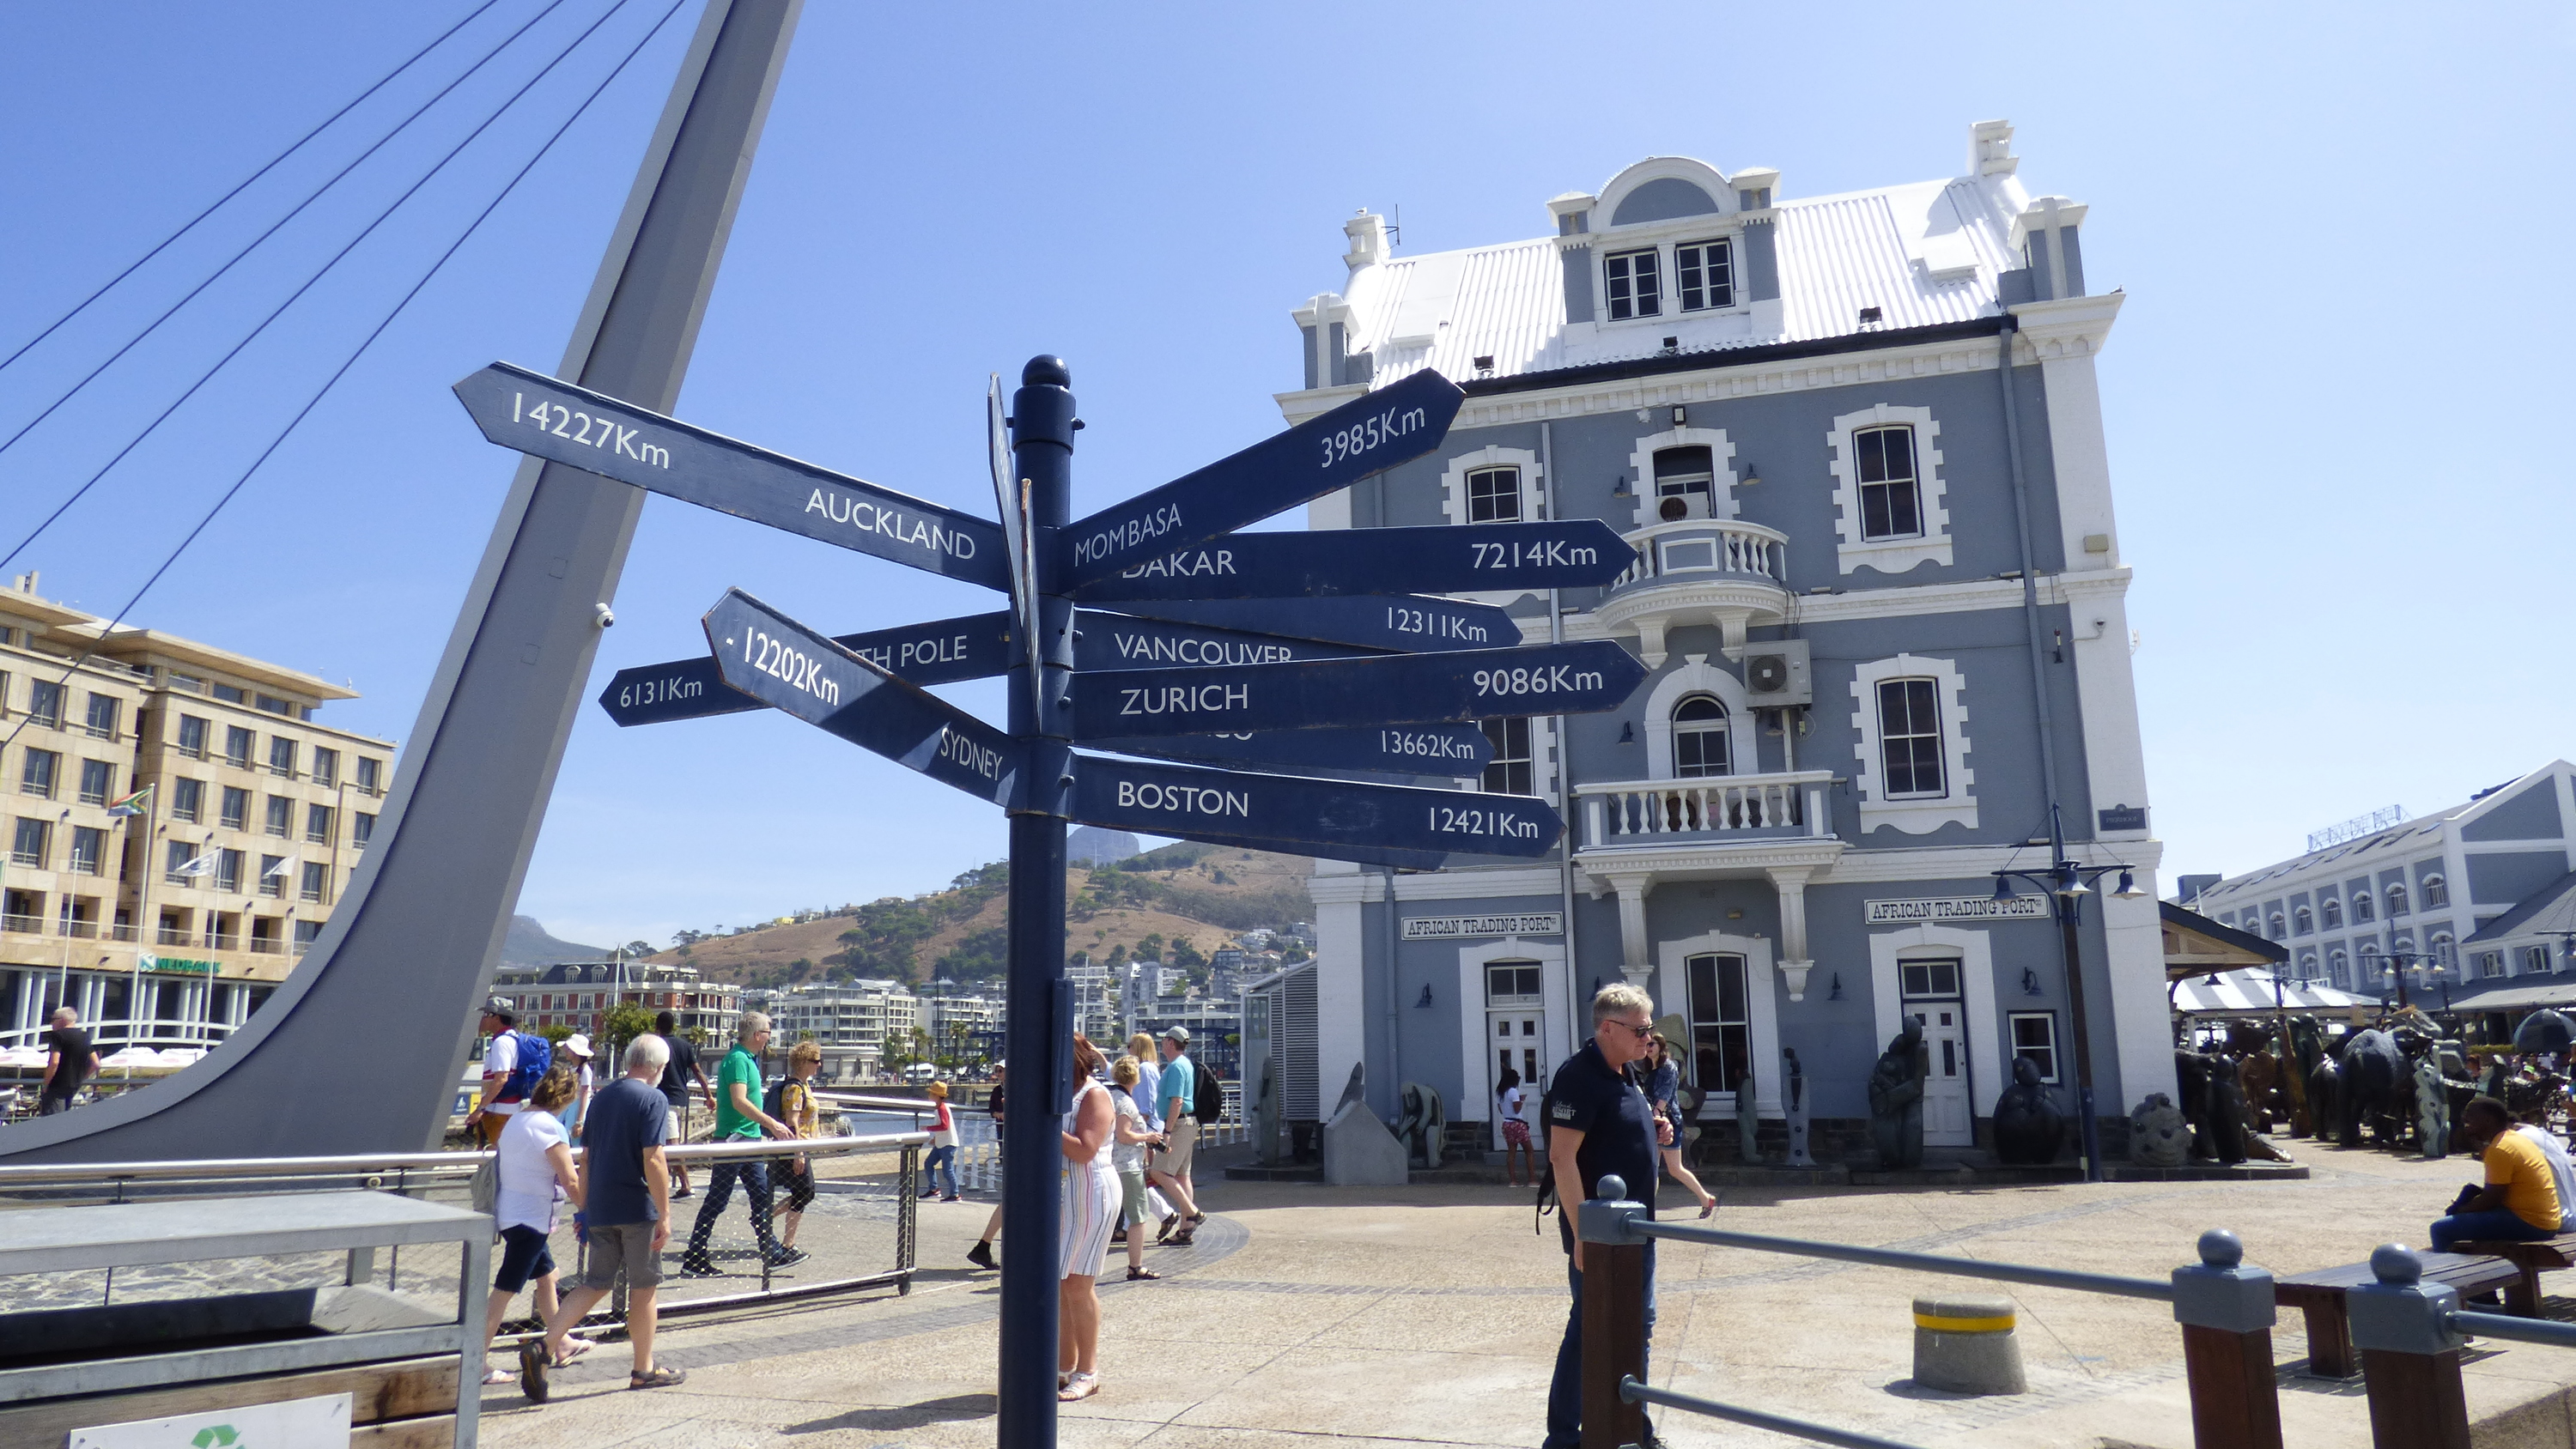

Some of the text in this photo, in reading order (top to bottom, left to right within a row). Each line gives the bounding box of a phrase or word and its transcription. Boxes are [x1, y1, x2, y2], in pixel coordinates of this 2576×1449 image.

[513, 391, 669, 470] 14227Km
[1321, 404, 1425, 468] 3985Km
[805, 488, 975, 560] AUCKLAND
[1075, 502, 1182, 567] MOMBASA
[1471, 541, 1597, 569] 7214Km
[1387, 606, 1488, 643] 12311Km
[744, 627, 839, 706] 12202Km
[1115, 634, 1292, 665] VANCOUVER
[619, 676, 702, 709] 6131Km
[901, 635, 967, 667] POLE
[1473, 664, 1603, 697] 9086Km
[1120, 683, 1248, 715] ZURICH
[940, 727, 1003, 781] SYDNEY
[1381, 730, 1474, 760] 13662Km
[1118, 782, 1539, 839] BOSTON 12421Km
[1408, 919, 1460, 936] AFRICAN
[1463, 918, 1517, 933] TRADING
[1521, 917, 1551, 931] PORT
[1873, 902, 1931, 919] AFRICAN
[1935, 900, 1996, 917] TRADING
[2002, 899, 2035, 914] PORT
[156, 958, 222, 973] NEDBANK
